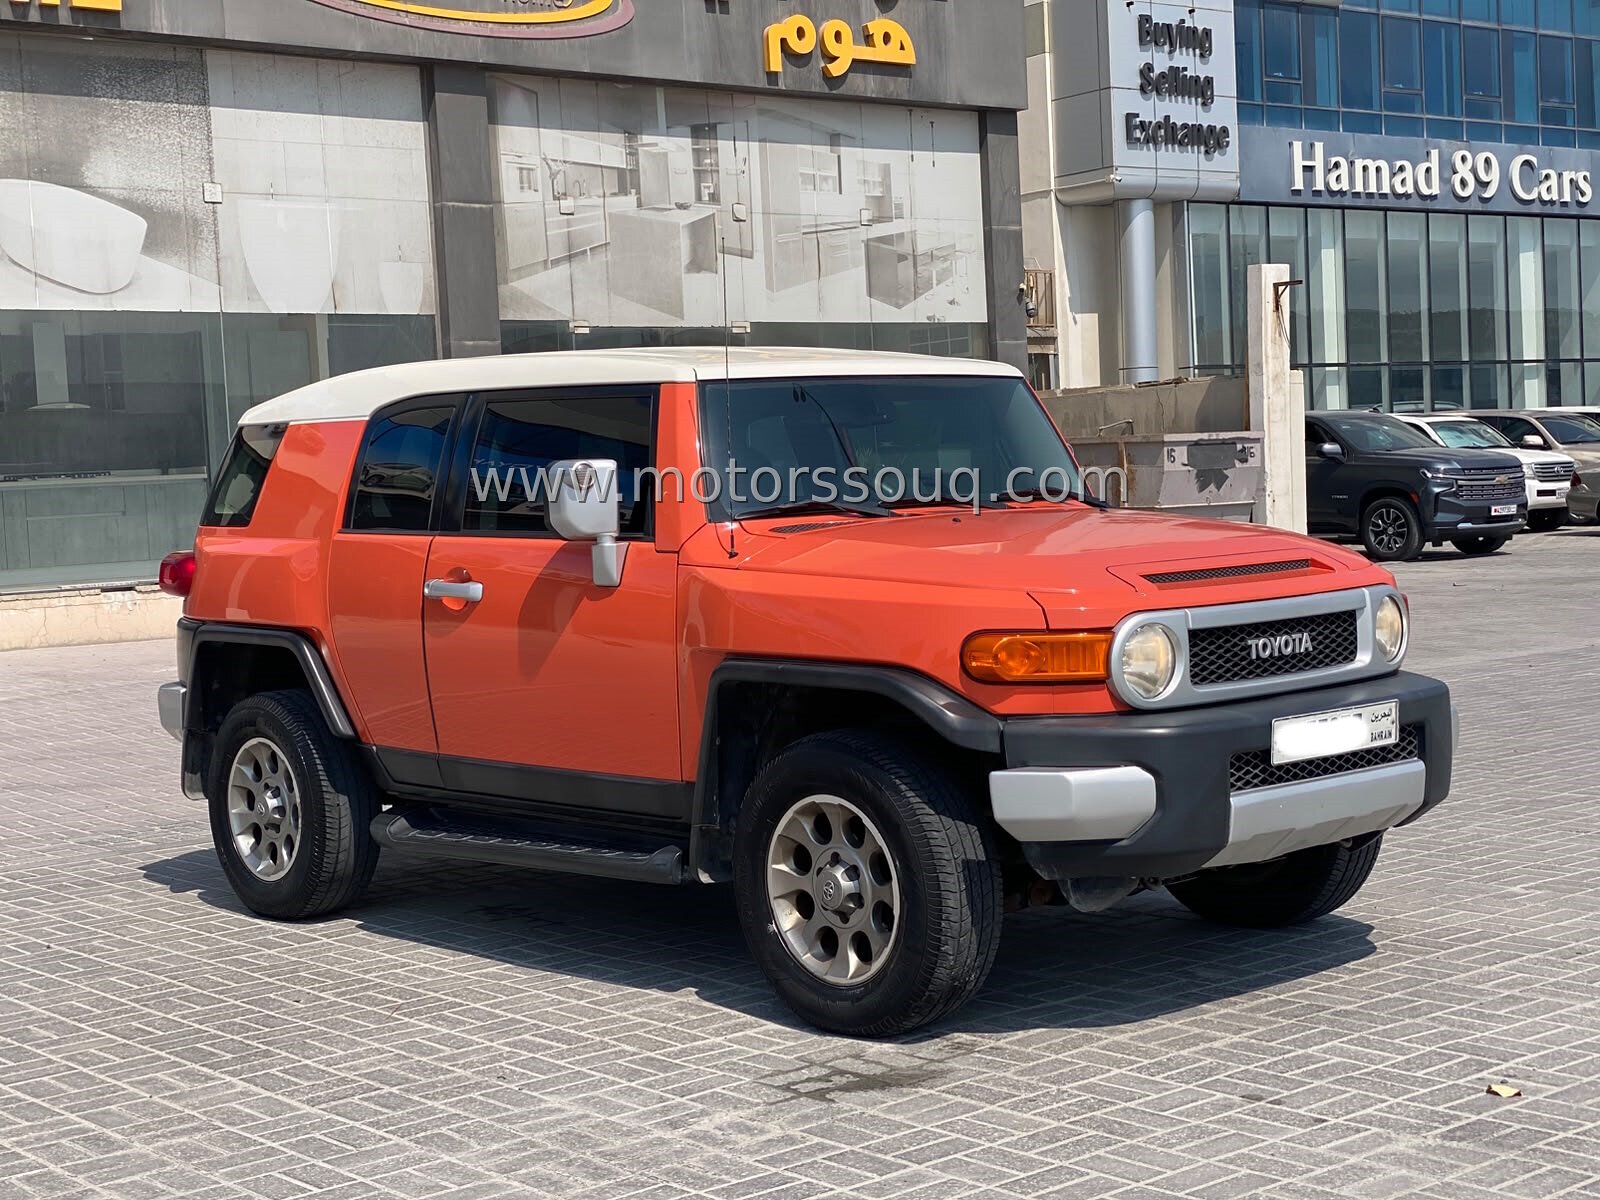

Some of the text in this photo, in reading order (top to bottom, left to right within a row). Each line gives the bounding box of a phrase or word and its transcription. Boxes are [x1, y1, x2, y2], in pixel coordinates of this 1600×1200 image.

[763, 14, 917, 78] هوم
[1137, 14, 1213, 58] Buying
[1139, 62, 1214, 106] Selling
[1125, 112, 1230, 155] Exchange
[1289, 141, 1593, 203] Hamad 89 Cars
[1247, 632, 1314, 660] TOYOTA
